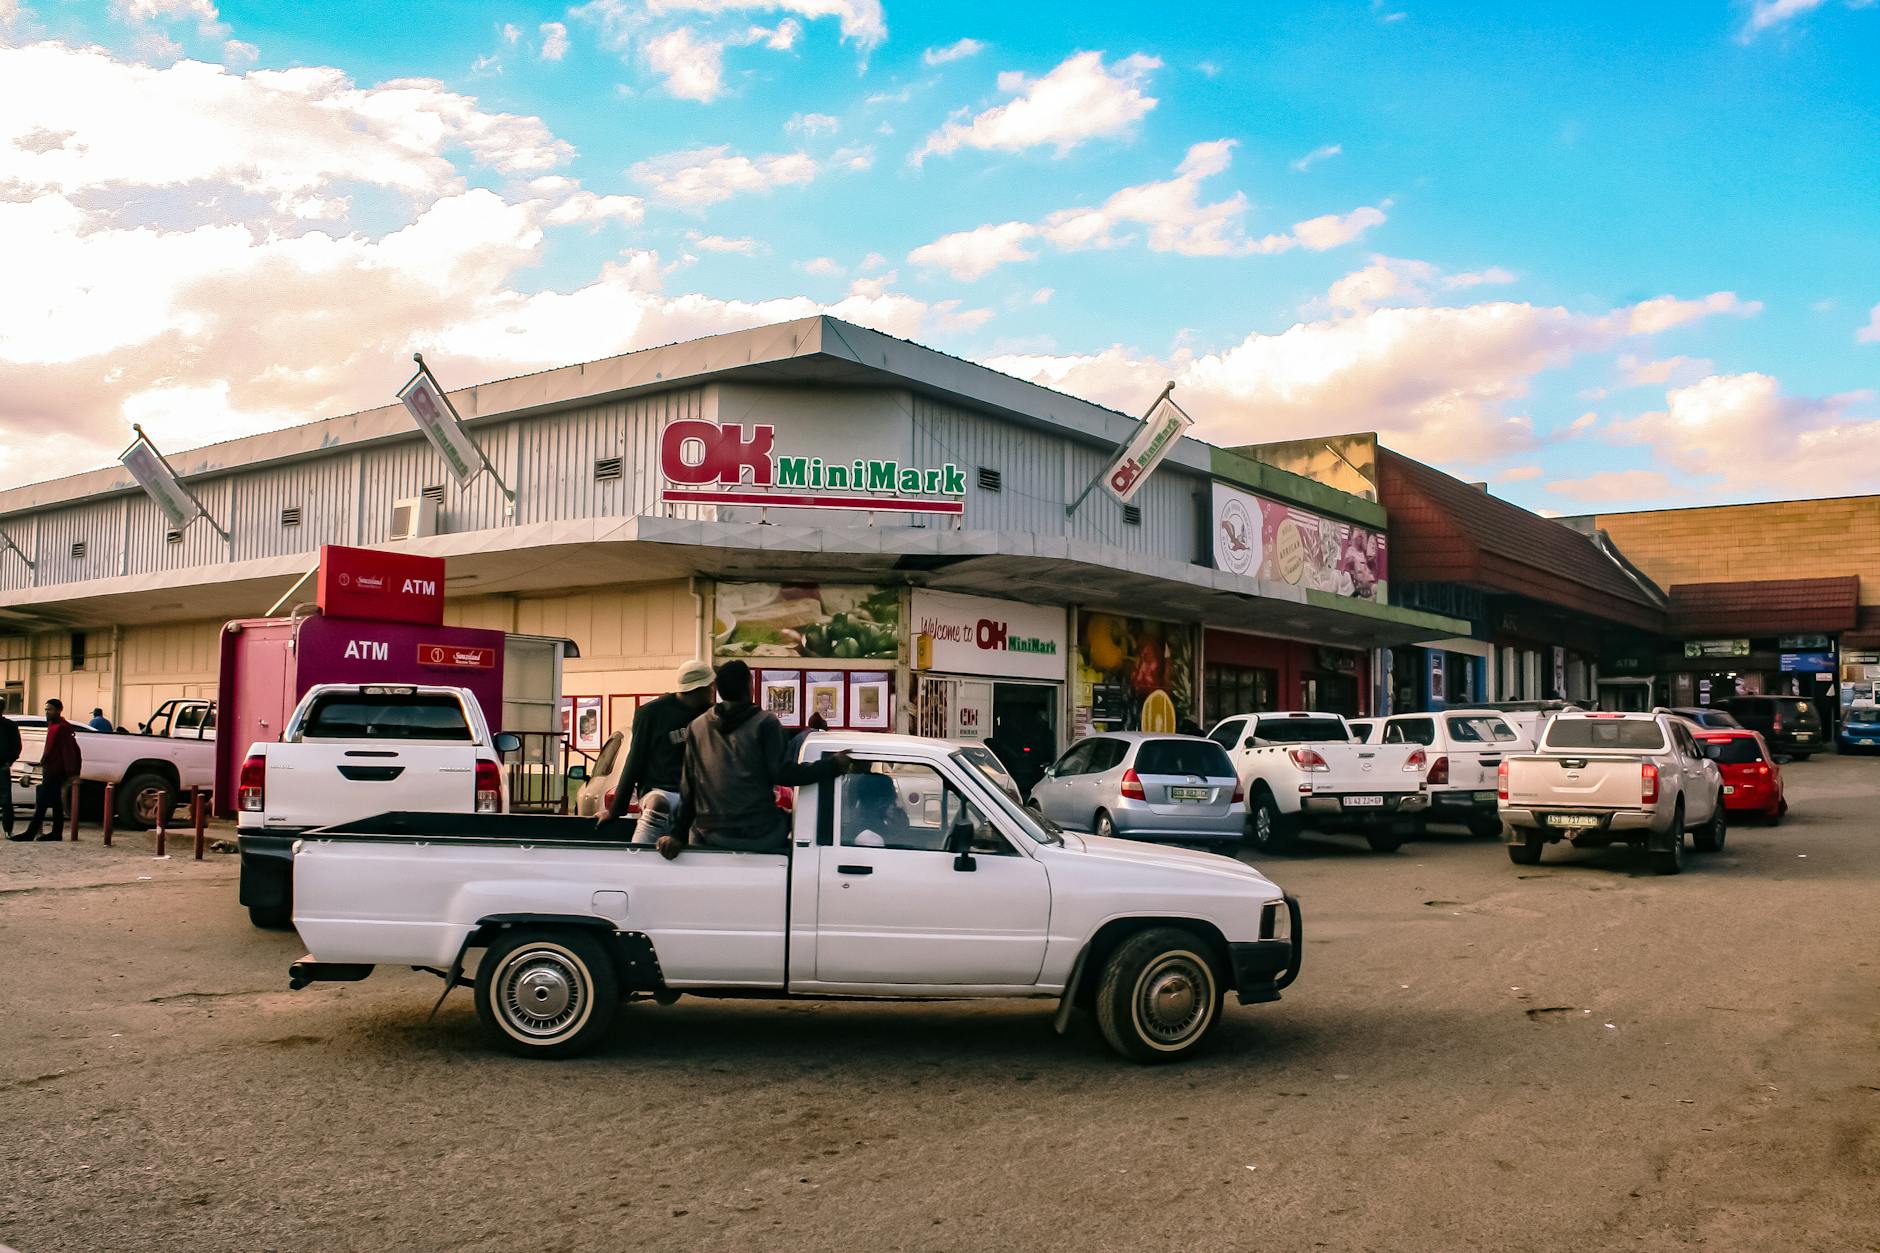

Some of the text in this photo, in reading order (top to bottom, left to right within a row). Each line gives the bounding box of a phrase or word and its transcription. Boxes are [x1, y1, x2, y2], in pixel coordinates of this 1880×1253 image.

[660, 418, 967, 495] OK MiniMark
[1110, 418, 1180, 492] OK MiniMark
[402, 578, 436, 596] ATM
[343, 639, 389, 661] ATM
[920, 616, 1057, 655] Welcome to OK MiniMark
